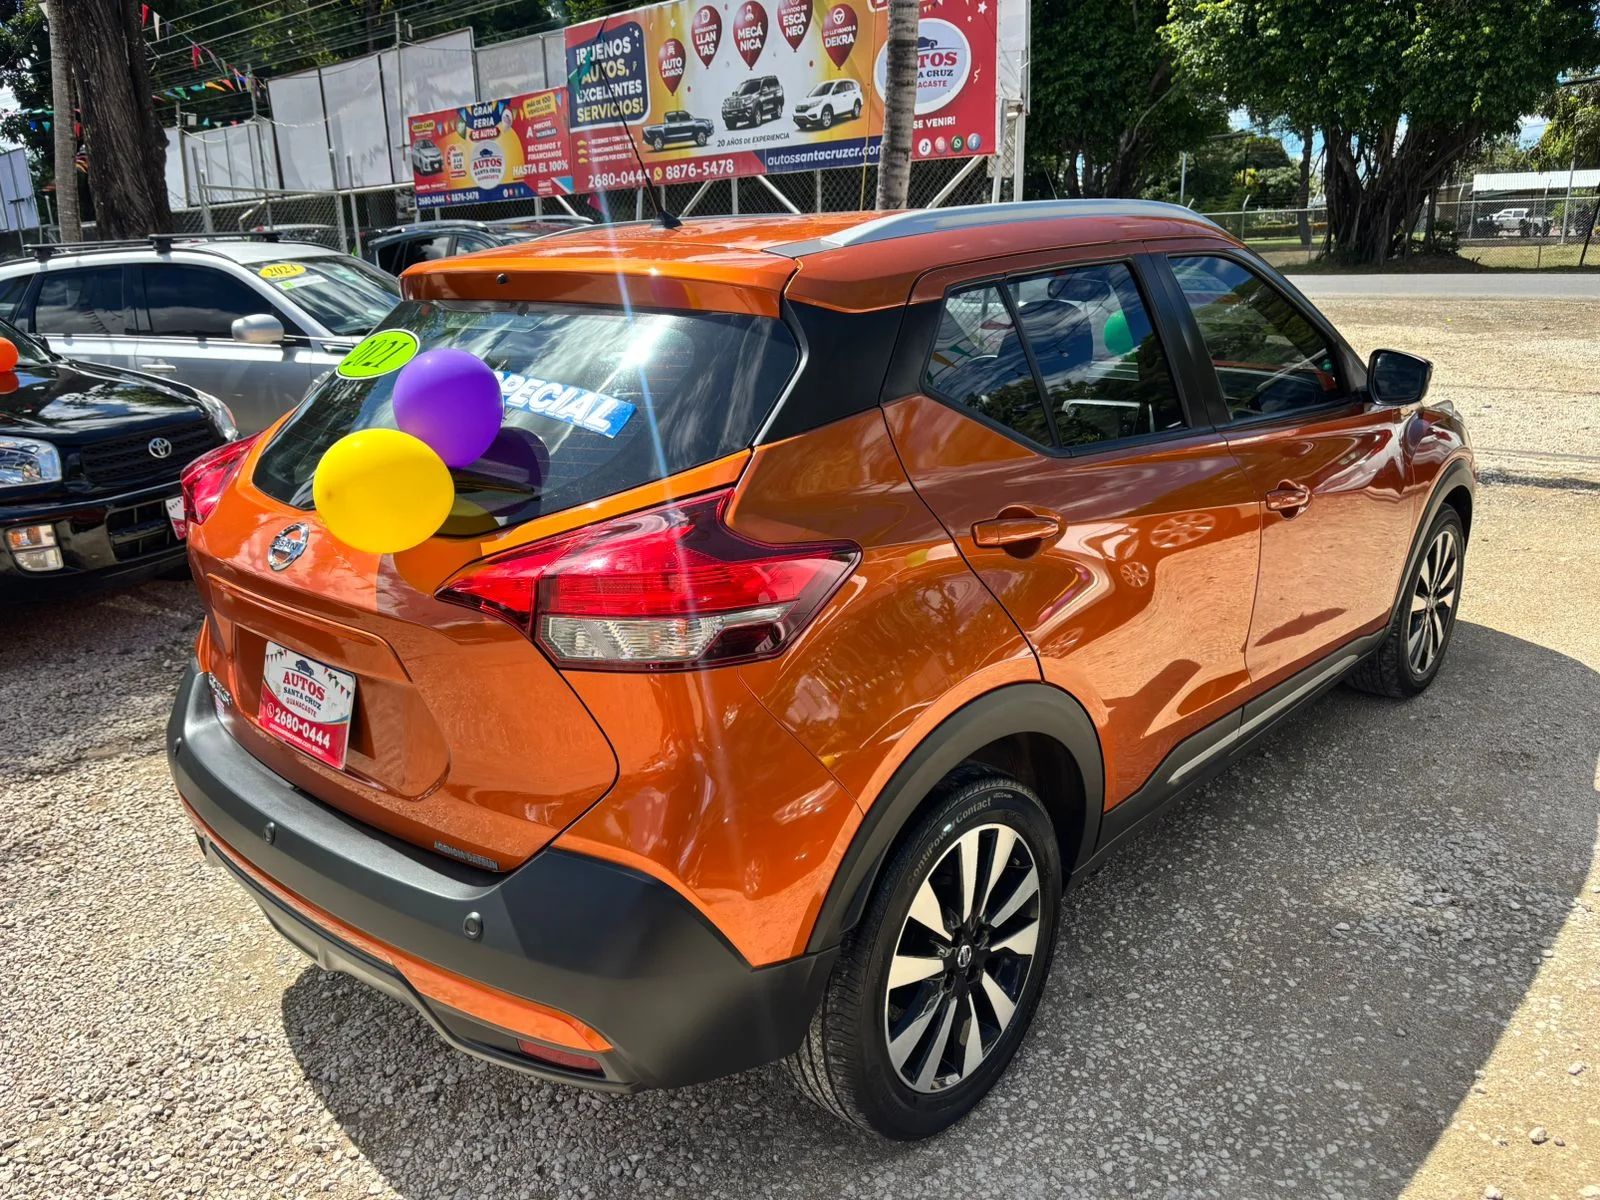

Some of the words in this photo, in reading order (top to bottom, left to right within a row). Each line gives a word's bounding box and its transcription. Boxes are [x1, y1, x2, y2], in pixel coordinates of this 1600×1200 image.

[782, 13, 807, 26] ESCA
[737, 22, 763, 39] MECÁ
[785, 25, 804, 37] NEO
[695, 31, 716, 45] LLAN
[740, 38, 762, 51] NICA
[825, 33, 855, 48] DEKRA
[698, 43, 715, 57] TAS
[662, 57, 683, 70] AUTO
[917, 51, 958, 69] TOS
[662, 68, 683, 78] LAVADO
[926, 69, 954, 78] CRUZ
[917, 80, 948, 89] ACASTE
[473, 104, 493, 116] GRAN
[577, 97, 644, 122] SERVICIOS!
[473, 118, 495, 129] FERIA
[925, 115, 956, 128] VENIR!
[472, 131, 480, 139] DE
[480, 129, 498, 138] AUTOS
[526, 126, 534, 138] A
[717, 139, 726, 147] 20
[726, 136, 743, 146] AÑOS
[752, 132, 790, 143] EXPERIENCIA
[527, 142, 556, 152] RECIBIMOS
[556, 141, 562, 149] Y
[527, 150, 562, 160] FINANCIAMOS
[473, 158, 502, 170] AUTOS
[512, 163, 537, 176] HASTA
[538, 162, 548, 173] EL
[548, 160, 569, 173] 100%
[665, 158, 734, 181] 8876-5478
[343, 339, 410, 368] 2021
[494, 371, 619, 433] PECIAL
[283, 671, 326, 702] AUTOS
[283, 686, 304, 700] SANTA
[304, 695, 322, 711] CRUZ
[286, 697, 317, 718] GUANACASTE
[274, 707, 330, 750] 2680-0444
